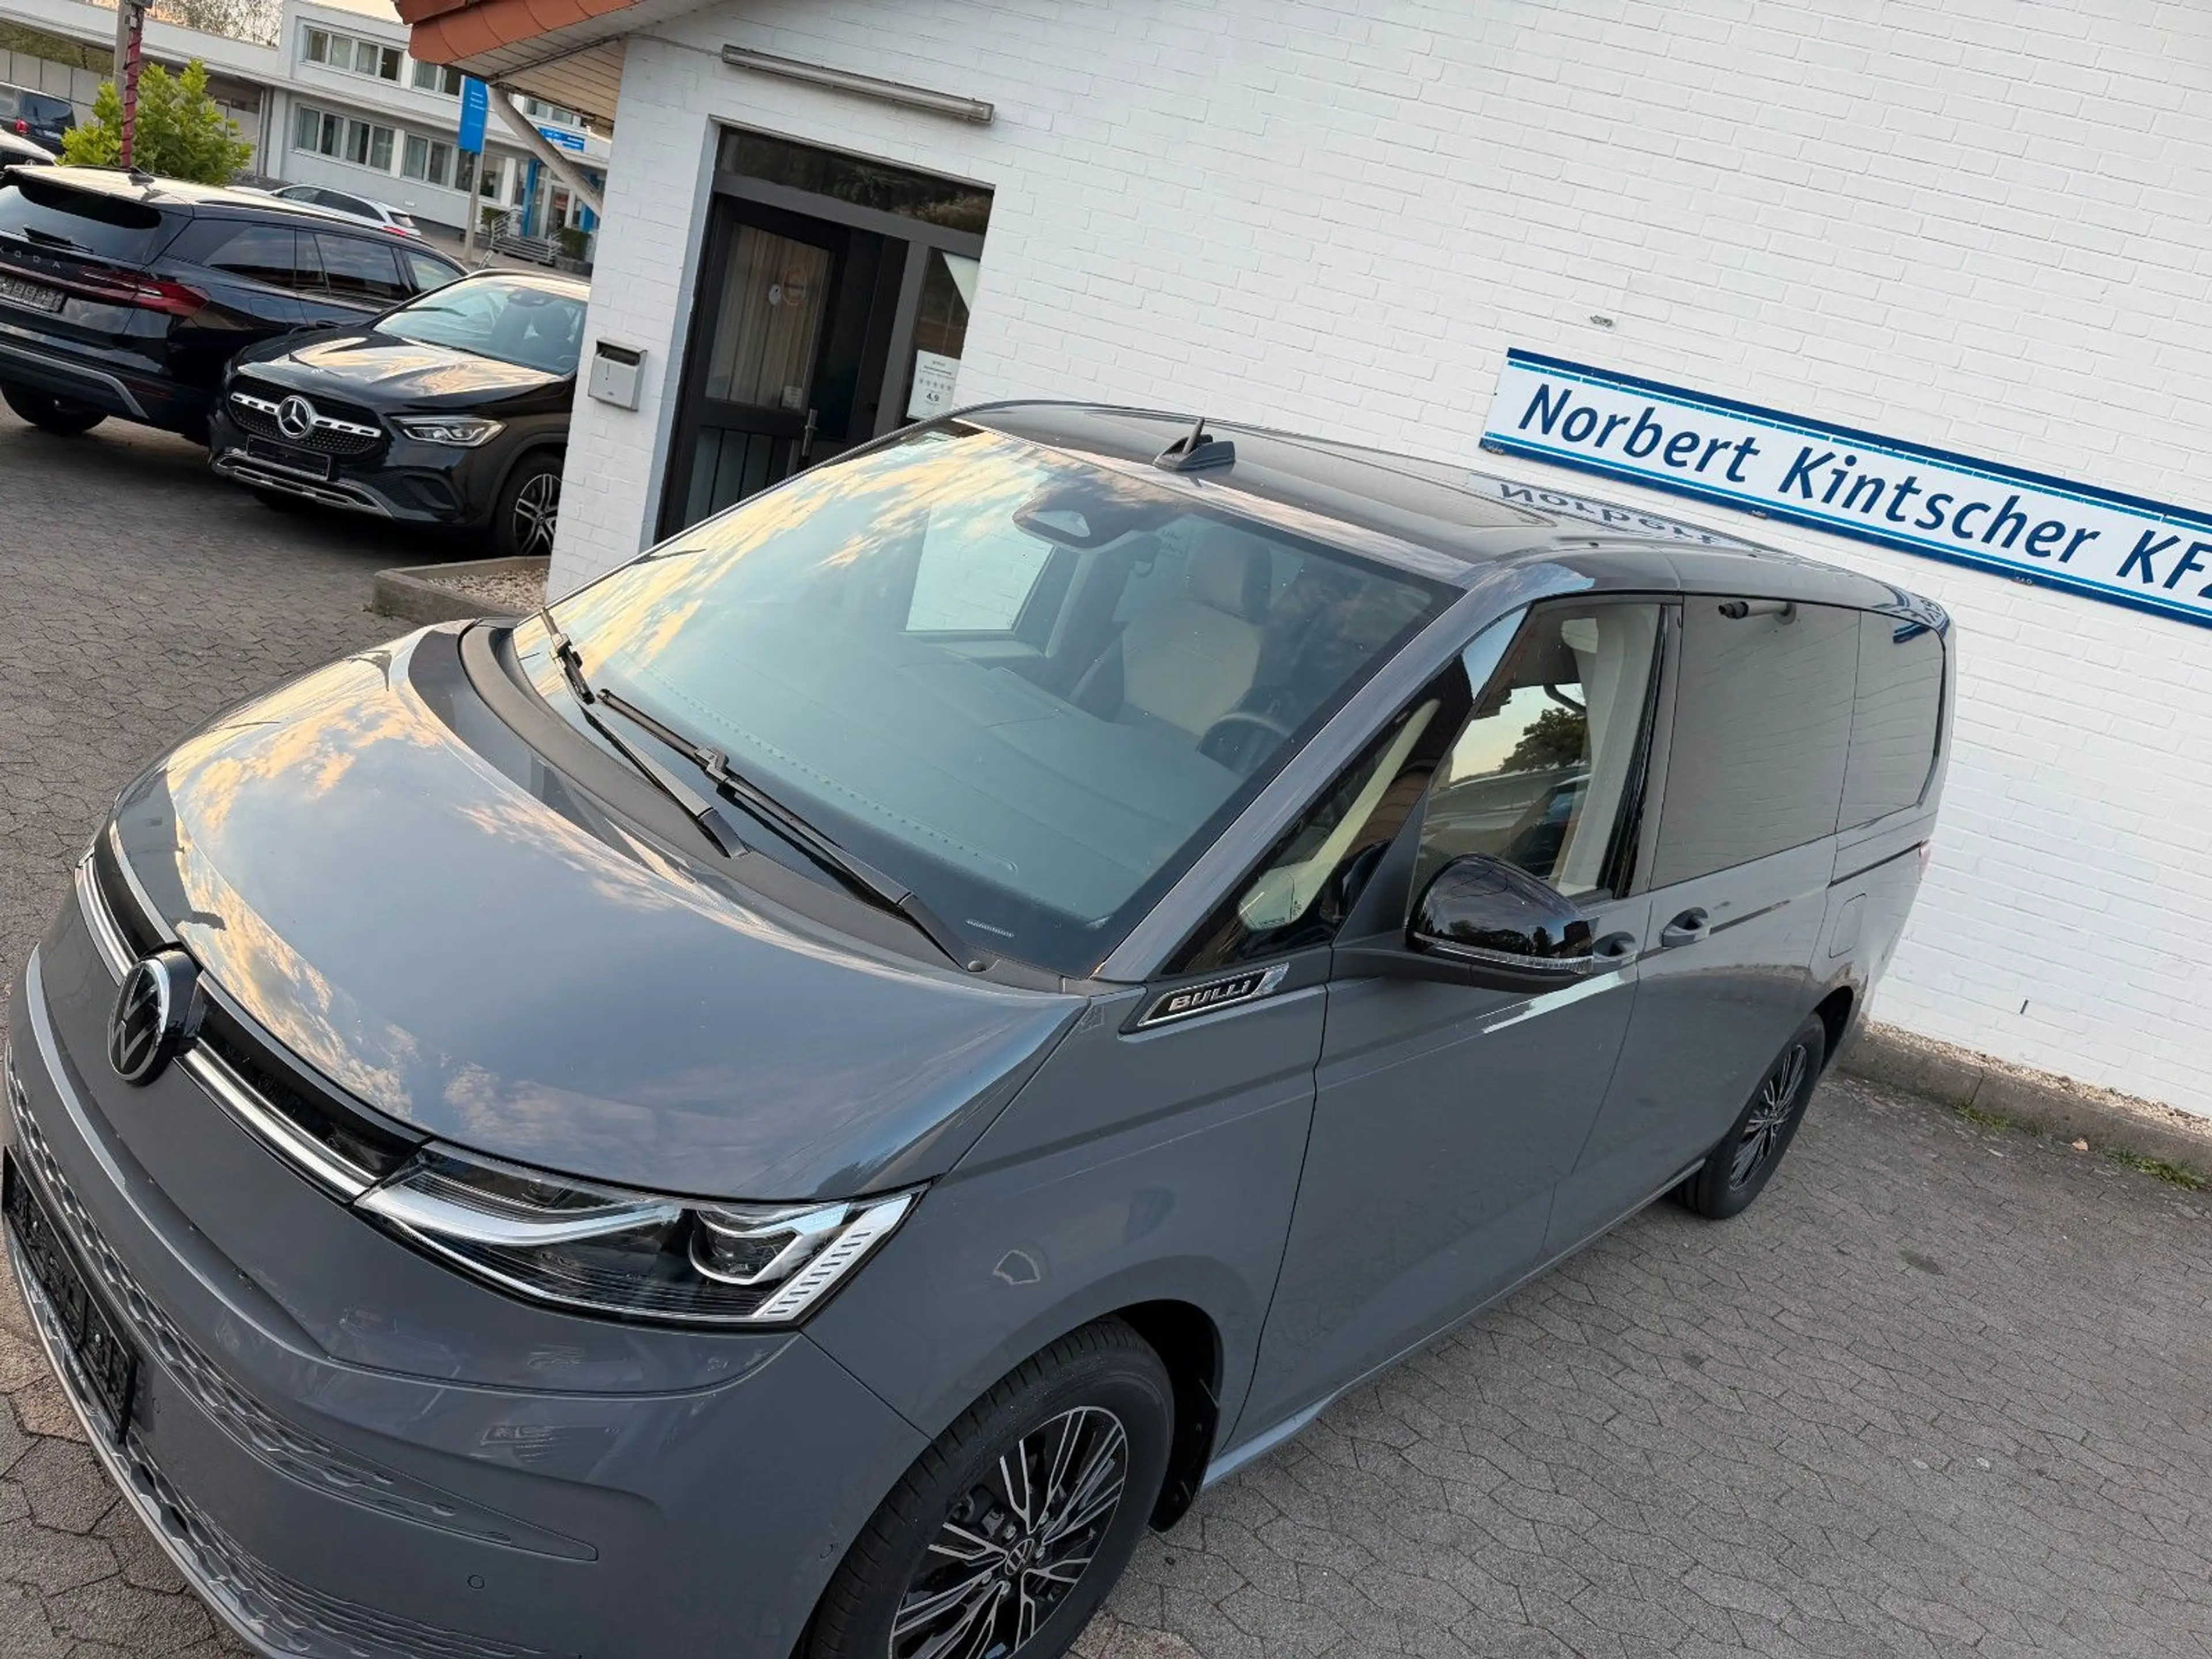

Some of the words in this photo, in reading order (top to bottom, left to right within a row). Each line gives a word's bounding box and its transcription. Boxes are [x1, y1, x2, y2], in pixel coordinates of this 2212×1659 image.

[1518, 383, 1761, 483] Norbert
[1778, 446, 2101, 563] Kintscher
[1168, 979, 1251, 1012] BULLI
